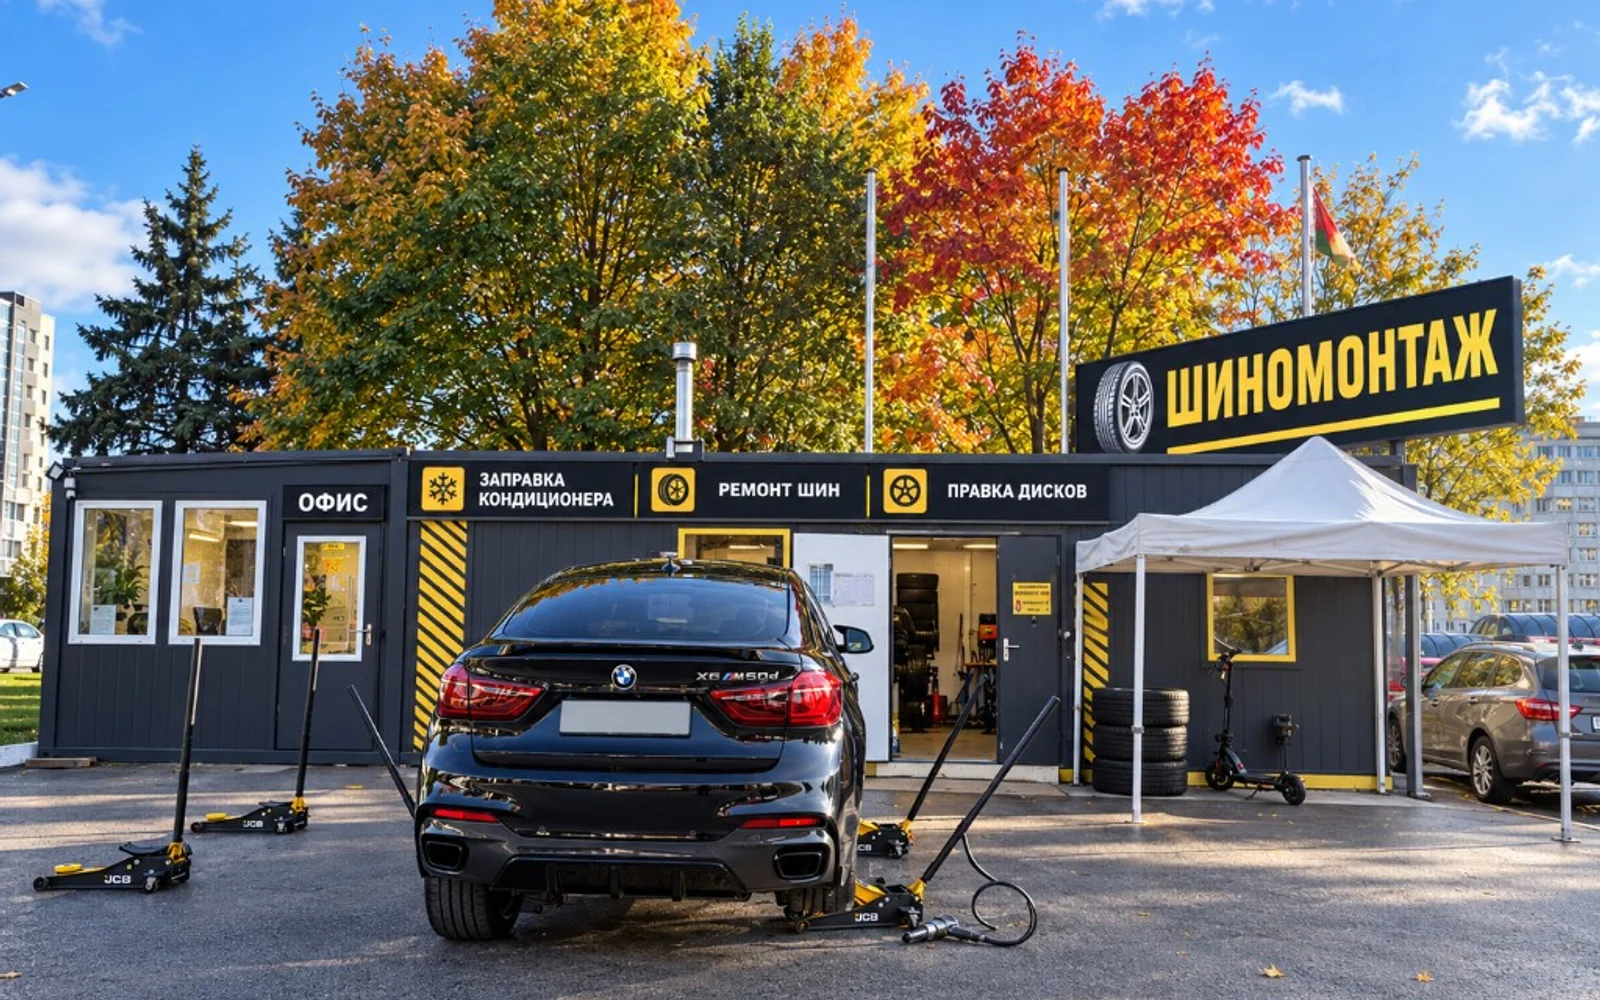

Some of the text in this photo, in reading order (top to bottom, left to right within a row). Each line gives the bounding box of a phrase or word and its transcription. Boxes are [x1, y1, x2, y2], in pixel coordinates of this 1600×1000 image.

[1167, 308, 1499, 428] ШИНОМОНТАЖ
[479, 471, 566, 488] ЗАПРАВКА
[718, 482, 841, 499] РЕМОНТ ШИН
[947, 483, 1088, 501] ПРАВКА ДИСКОВ
[297, 491, 369, 514] ОФИС
[478, 491, 615, 509] КОНДИЦИОНЕРА
[104, 874, 132, 885] JCB
[854, 912, 879, 922] JCB
